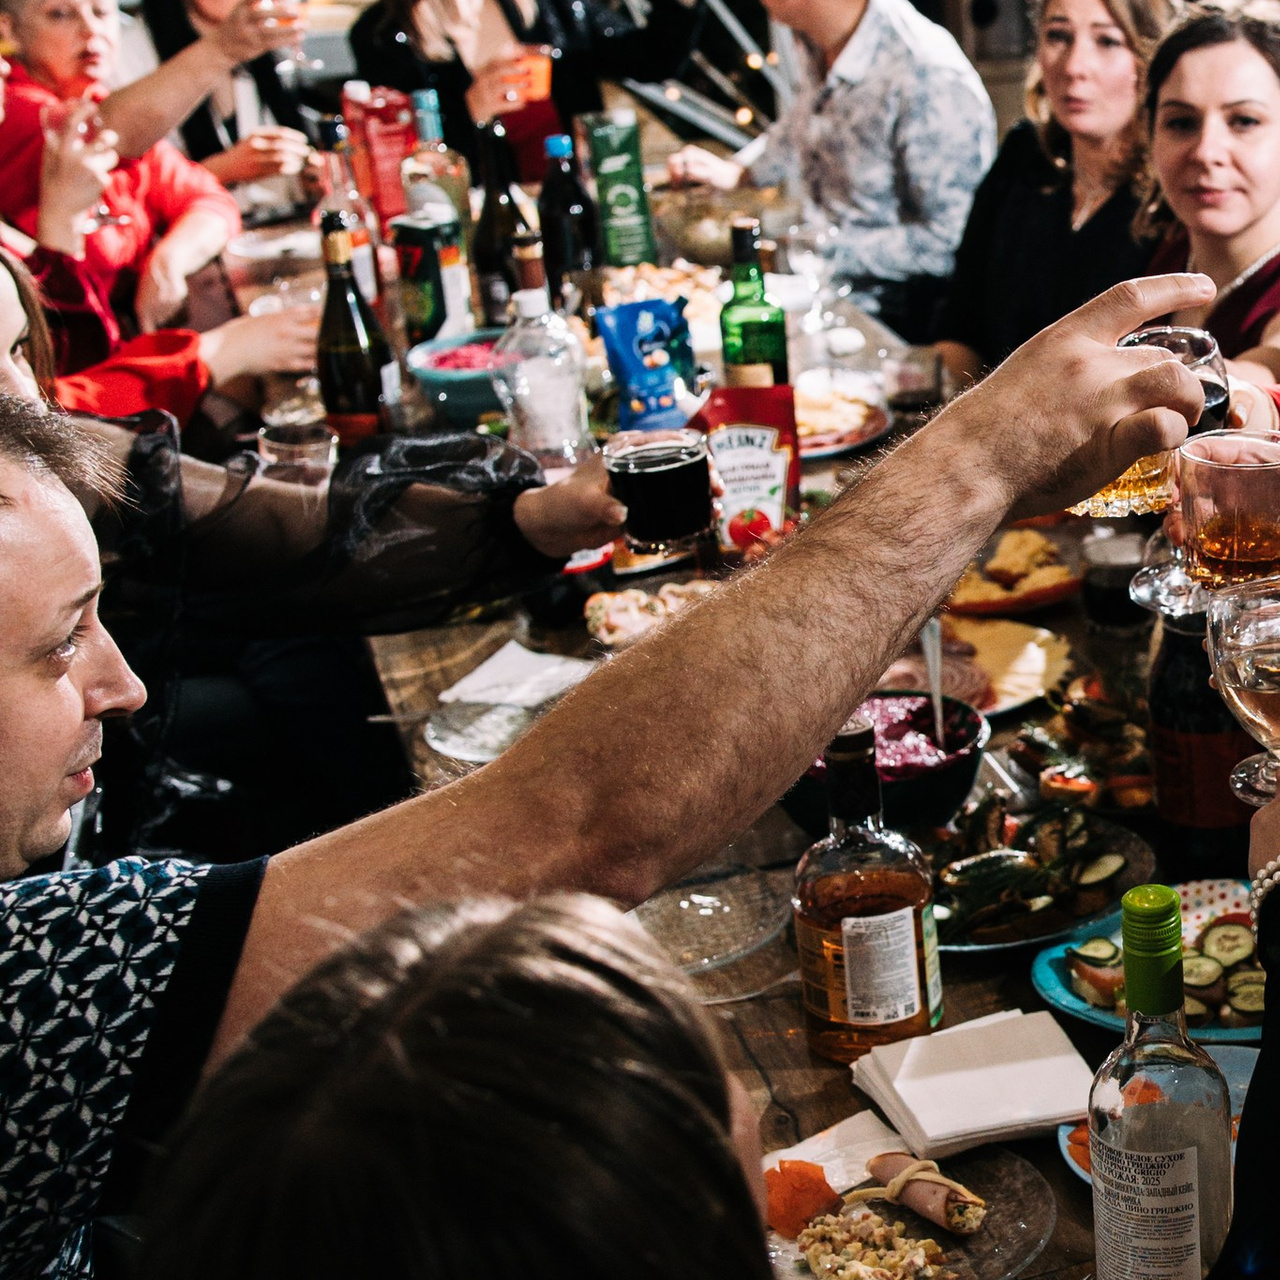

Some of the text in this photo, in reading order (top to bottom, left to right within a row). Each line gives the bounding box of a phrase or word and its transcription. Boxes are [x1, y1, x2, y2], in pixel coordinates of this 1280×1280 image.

[1125, 1151, 1152, 1163] БЕЛОЕ
[1154, 1152, 1186, 1164] СУХОЕ
[1110, 1162, 1167, 1177] PINOT GRIGIO
[1127, 1160, 1171, 1170] ГРИДЖИО
[1104, 1163, 1140, 1185] УРОЖАЯ:
[1141, 1176, 1161, 1187] 2025
[1146, 1183, 1177, 1199] ЗАПАДНЫЙ
[1125, 1203, 1149, 1215] ПИНО
[1150, 1203, 1194, 1215] ГРИДЖИО
